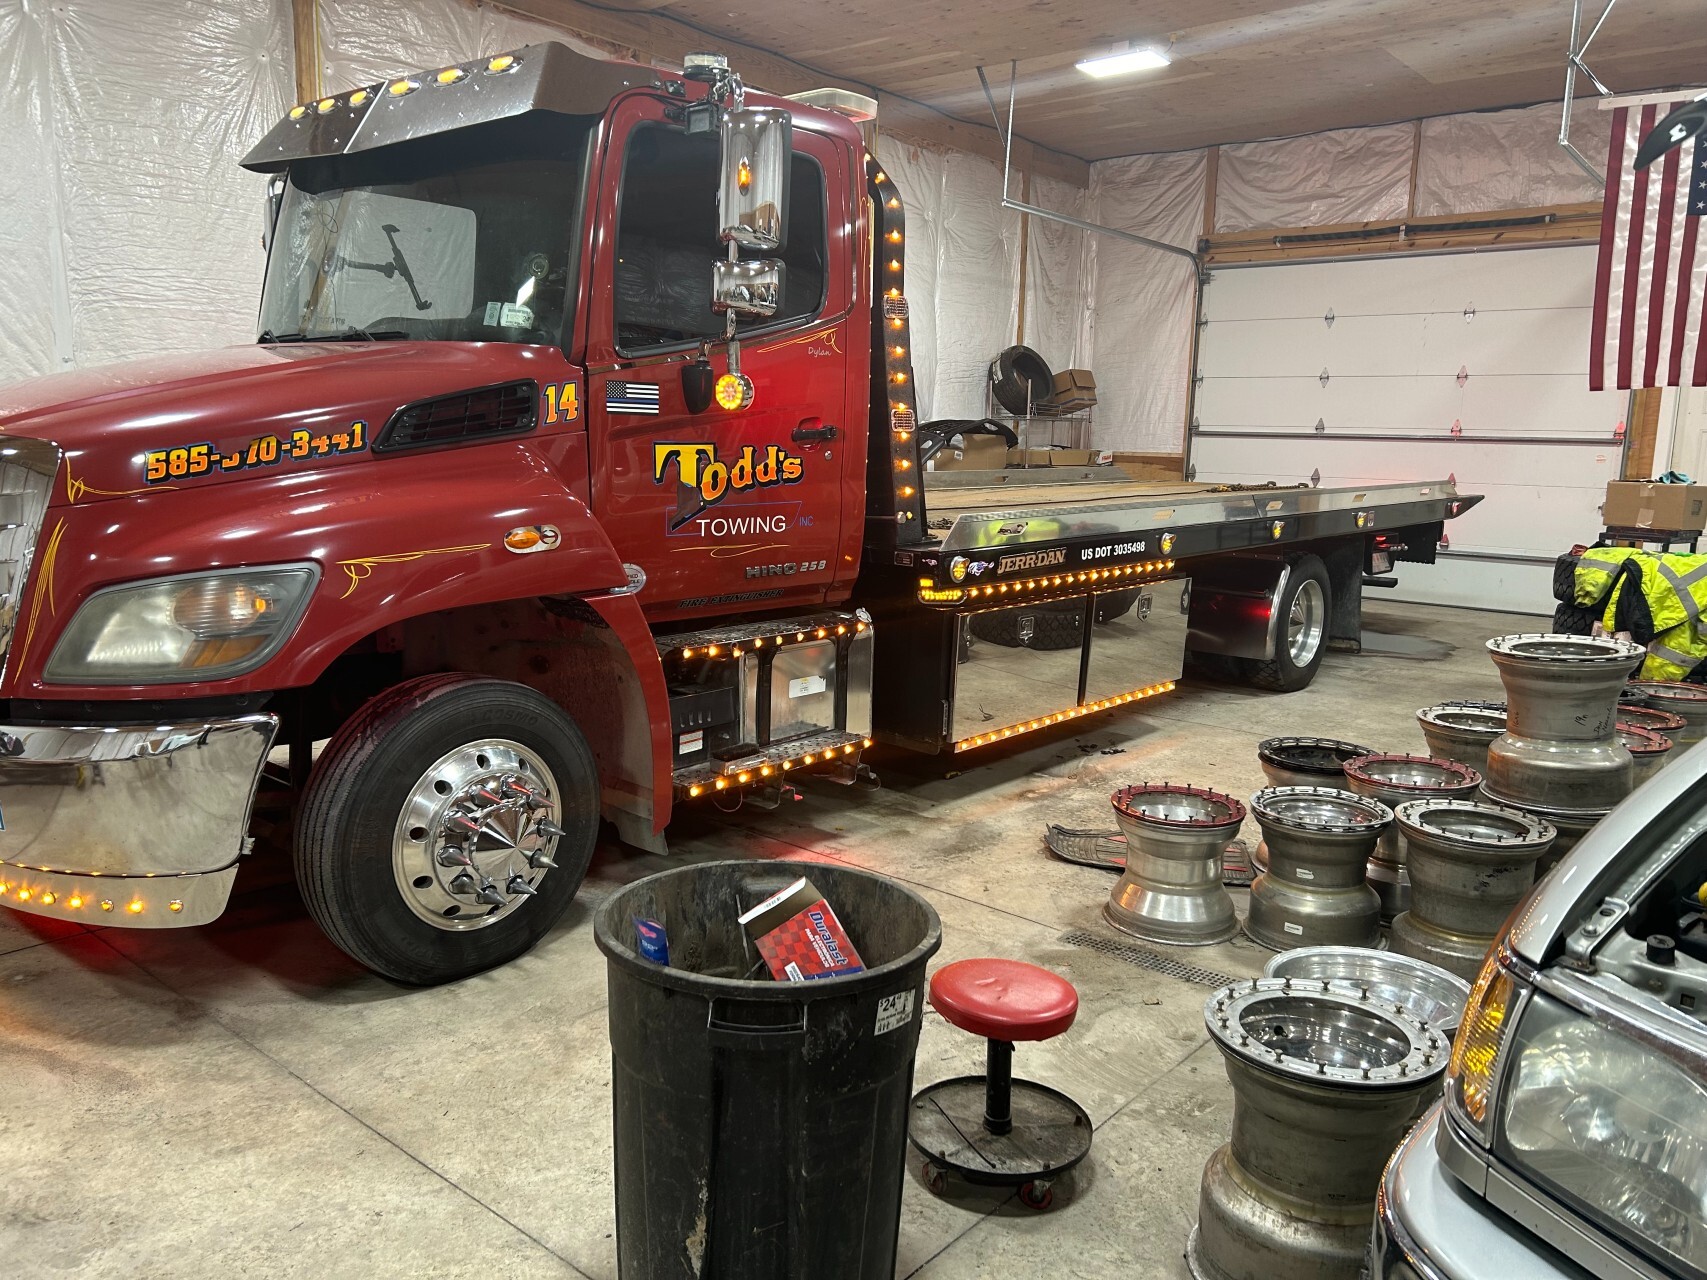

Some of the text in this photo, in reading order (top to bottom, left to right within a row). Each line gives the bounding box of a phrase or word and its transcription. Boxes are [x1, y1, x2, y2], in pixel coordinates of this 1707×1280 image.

[808, 346, 832, 358] Dylan
[542, 381, 580, 425] 14
[653, 442, 804, 524] Todd's
[696, 515, 814, 537] TOWING INC
[1081, 541, 1146, 561] US DOT 3035498
[745, 559, 827, 580] HINO 258
[679, 588, 785, 609] FIRE EXTINGUISHER
[808, 911, 848, 965] Duralast
